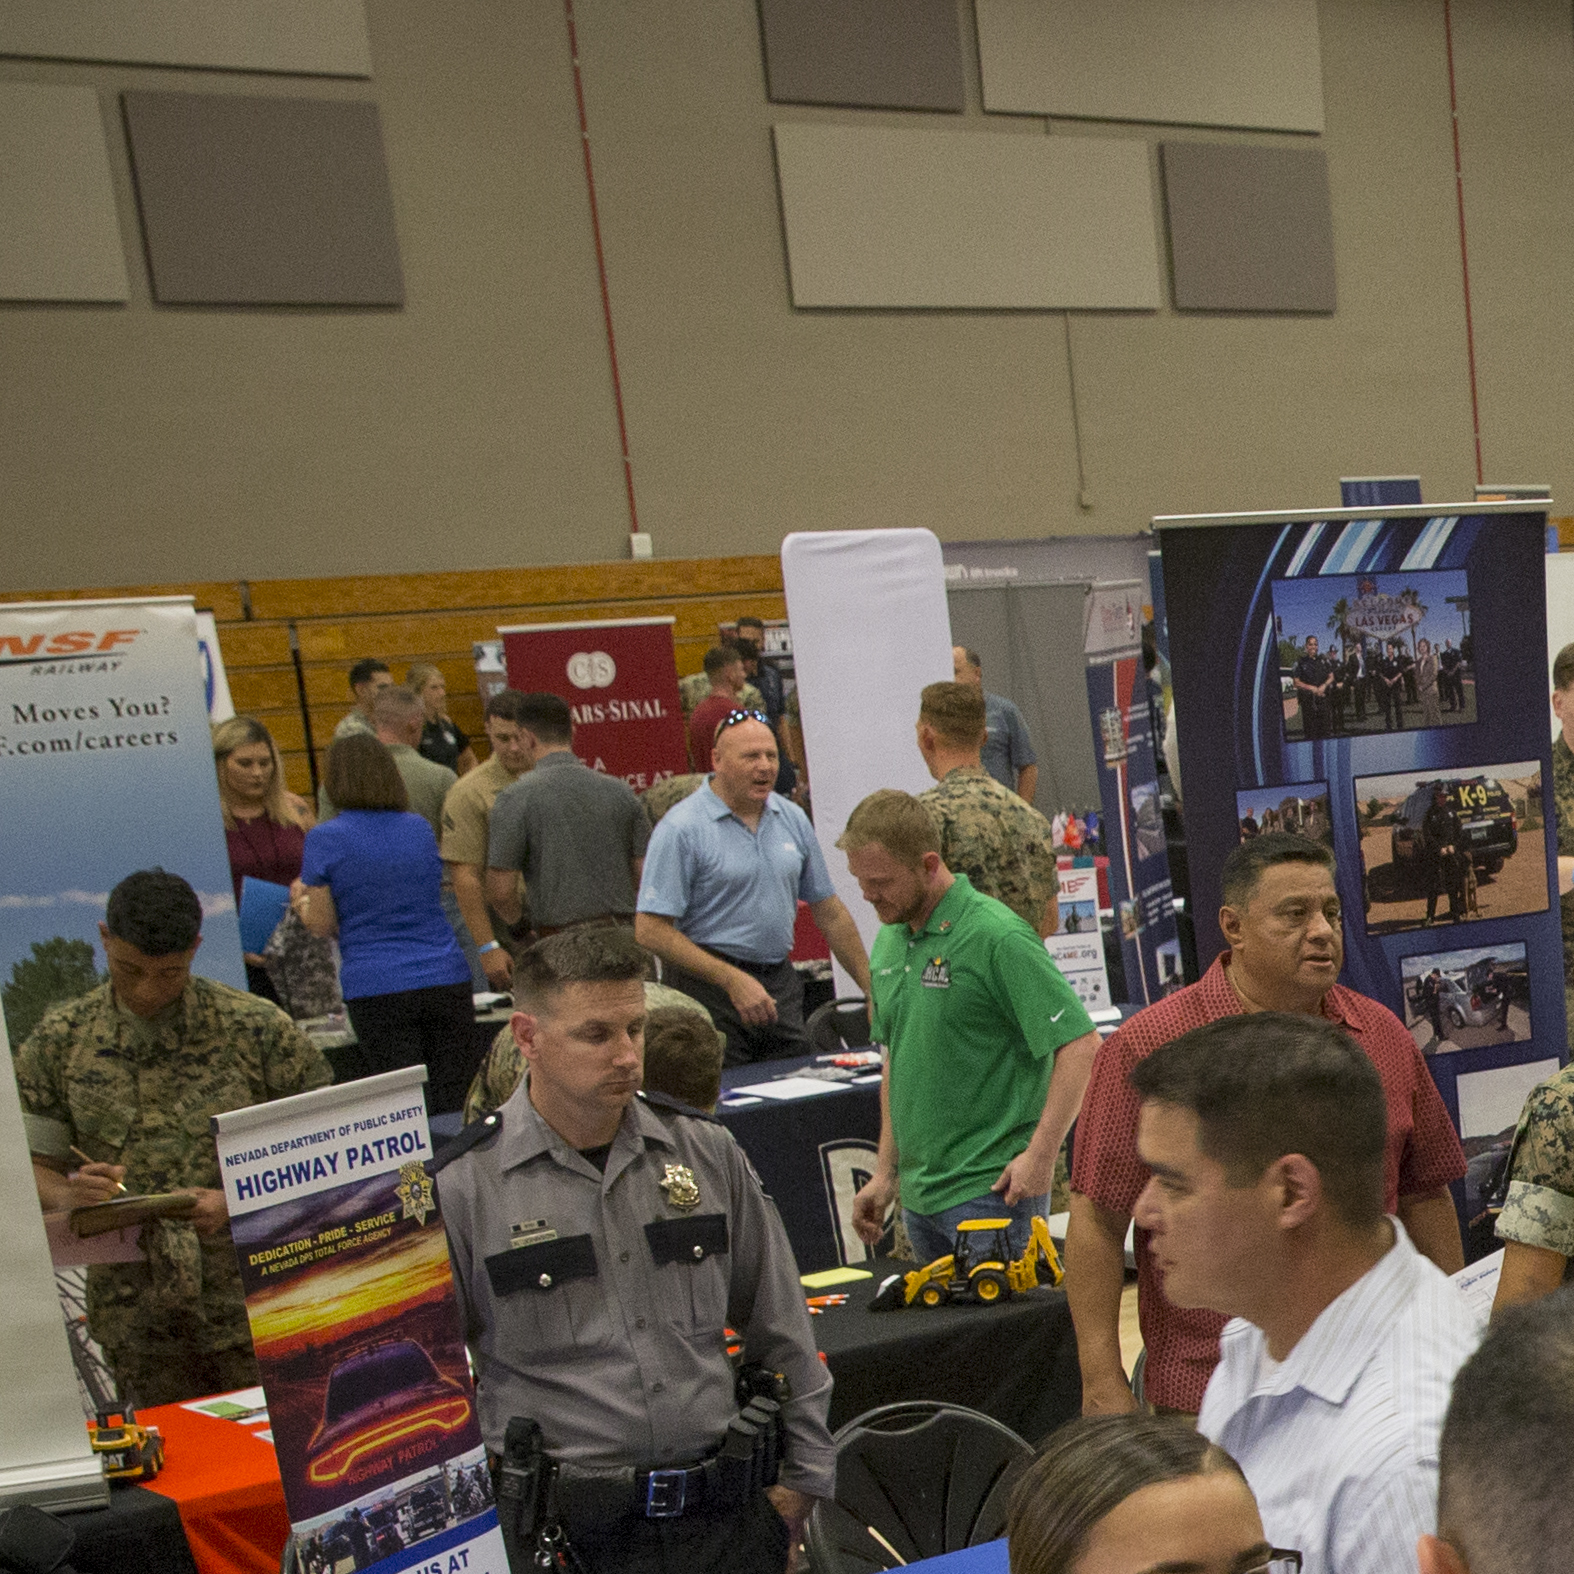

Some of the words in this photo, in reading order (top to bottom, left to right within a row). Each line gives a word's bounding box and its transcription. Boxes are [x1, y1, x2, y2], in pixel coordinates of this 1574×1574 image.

[1377, 613, 1414, 625] VEGAS
[0, 629, 140, 656] NSF
[31, 661, 121, 676] RAILWAY
[13, 702, 99, 724] Moves
[108, 696, 170, 719] You?
[572, 699, 663, 724] ARS-SINAI
[1459, 785, 1487, 807] K-9
[226, 1149, 269, 1167] NEVADA
[271, 1129, 336, 1155] DEPARTMENT
[339, 1124, 352, 1136] OF
[354, 1115, 388, 1133] PUBLIC
[390, 1105, 424, 1123] SAFETY
[236, 1152, 339, 1200] HIGHWAY
[346, 1130, 426, 1170] PATROL
[250, 1238, 312, 1266] DEDICATION
[318, 1226, 347, 1244] PRIDE
[355, 1212, 396, 1232] SERVICE
[261, 1267, 268, 1276] A
[269, 1257, 299, 1275] NEVADA
[314, 1244, 337, 1261] TOTAL
[337, 1236, 362, 1253] FORCE
[362, 1227, 392, 1246] AGENCY
[448, 1549, 470, 1574] AT
